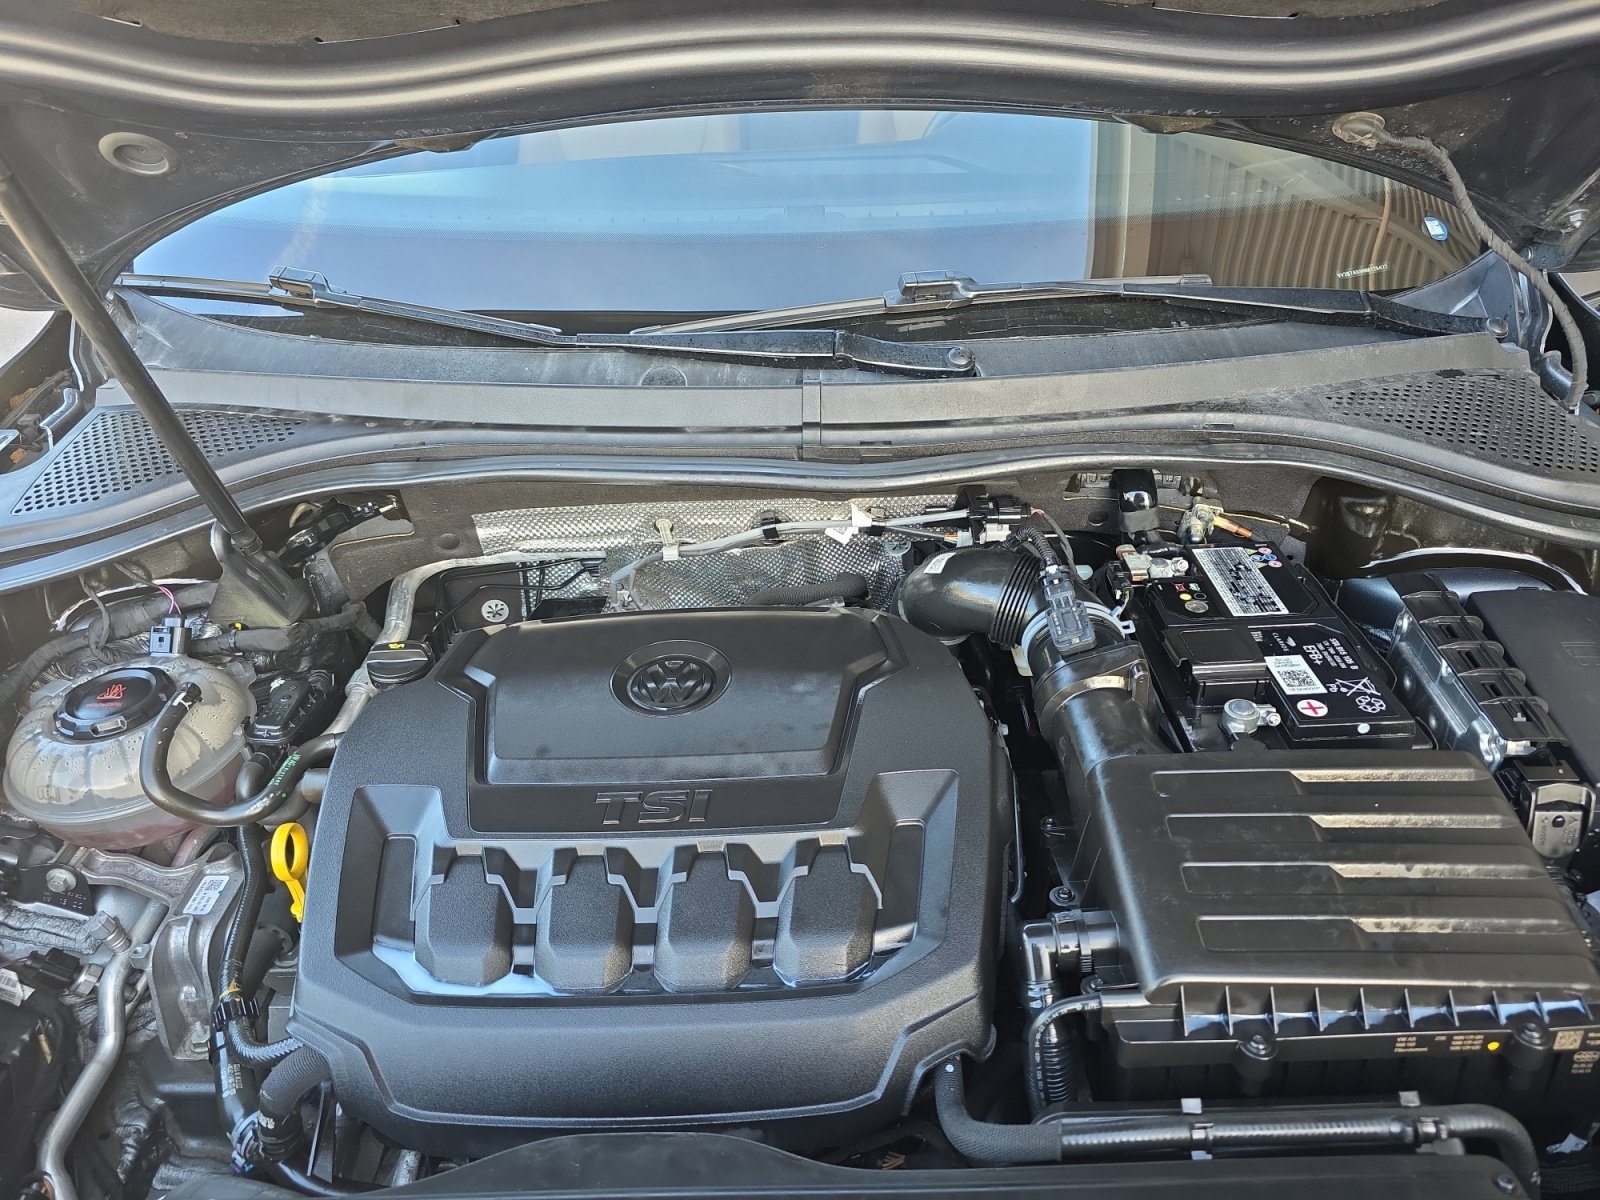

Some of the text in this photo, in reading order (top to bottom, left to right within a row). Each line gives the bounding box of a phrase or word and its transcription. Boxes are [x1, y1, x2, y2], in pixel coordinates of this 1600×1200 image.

[1272, 632, 1290, 652] CLARIOS
[1302, 645, 1323, 665] EFB+
[1325, 683, 1338, 692] Pb
[595, 789, 713, 825] TSI
